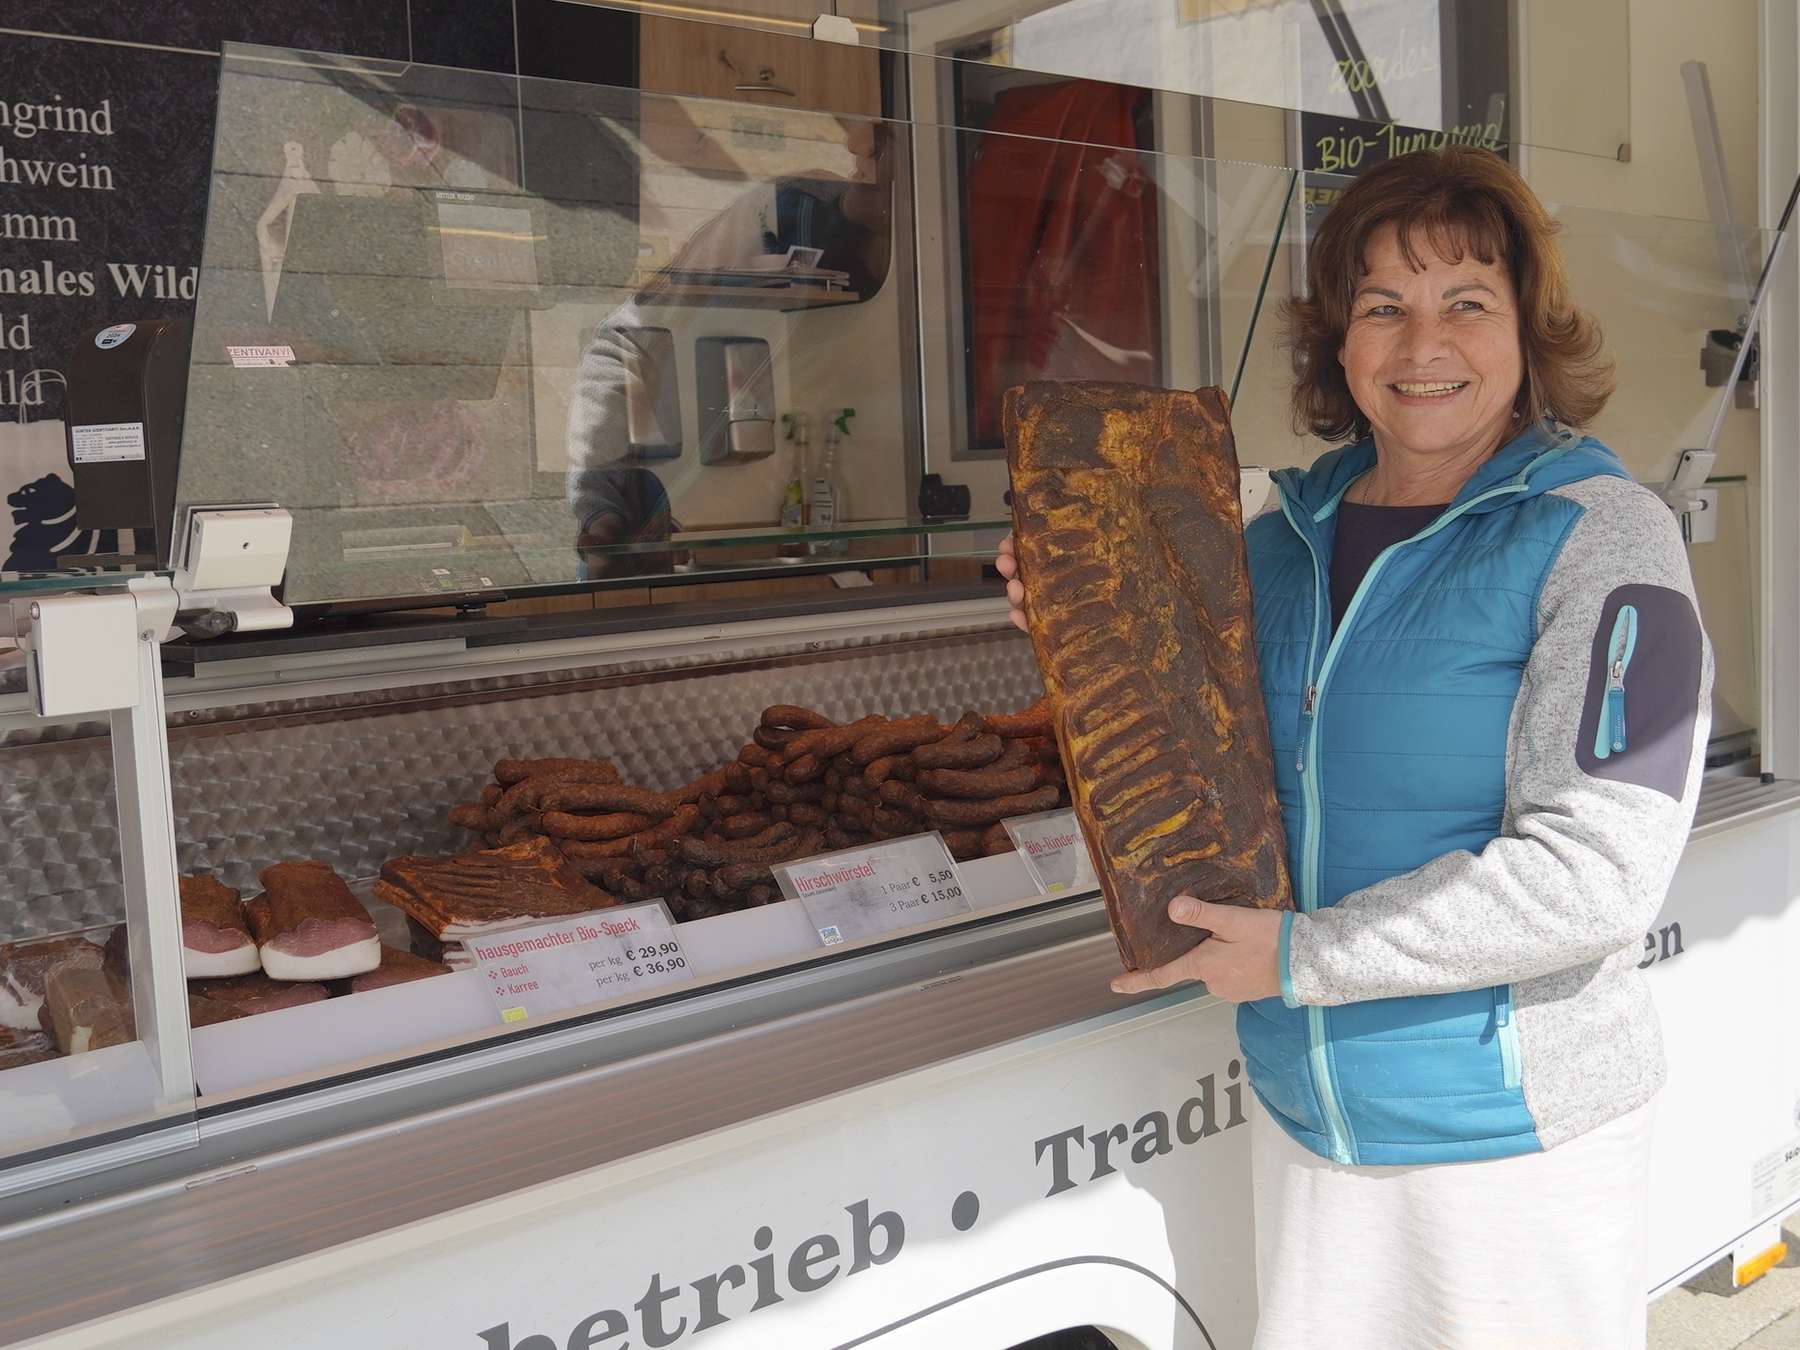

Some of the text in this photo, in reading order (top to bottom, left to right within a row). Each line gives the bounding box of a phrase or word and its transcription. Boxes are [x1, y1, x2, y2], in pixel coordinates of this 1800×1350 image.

[0, 212, 80, 242] mm
[106, 262, 198, 300] Wild
[794, 861, 876, 892] Hirschwürstel
[888, 881, 911, 893] Paar
[911, 876, 921, 887] €
[928, 869, 953, 884] 5,50
[889, 886, 962, 913] 3 Paar € 15,00
[475, 918, 641, 961] hausgemachter Bio-Speck
[500, 963, 529, 978] Bauch
[588, 941, 679, 972] per kg € 29,90
[507, 979, 540, 996] Karree
[595, 957, 686, 988] per kg € 36,90
[1034, 1058, 1253, 1198] Tradi
